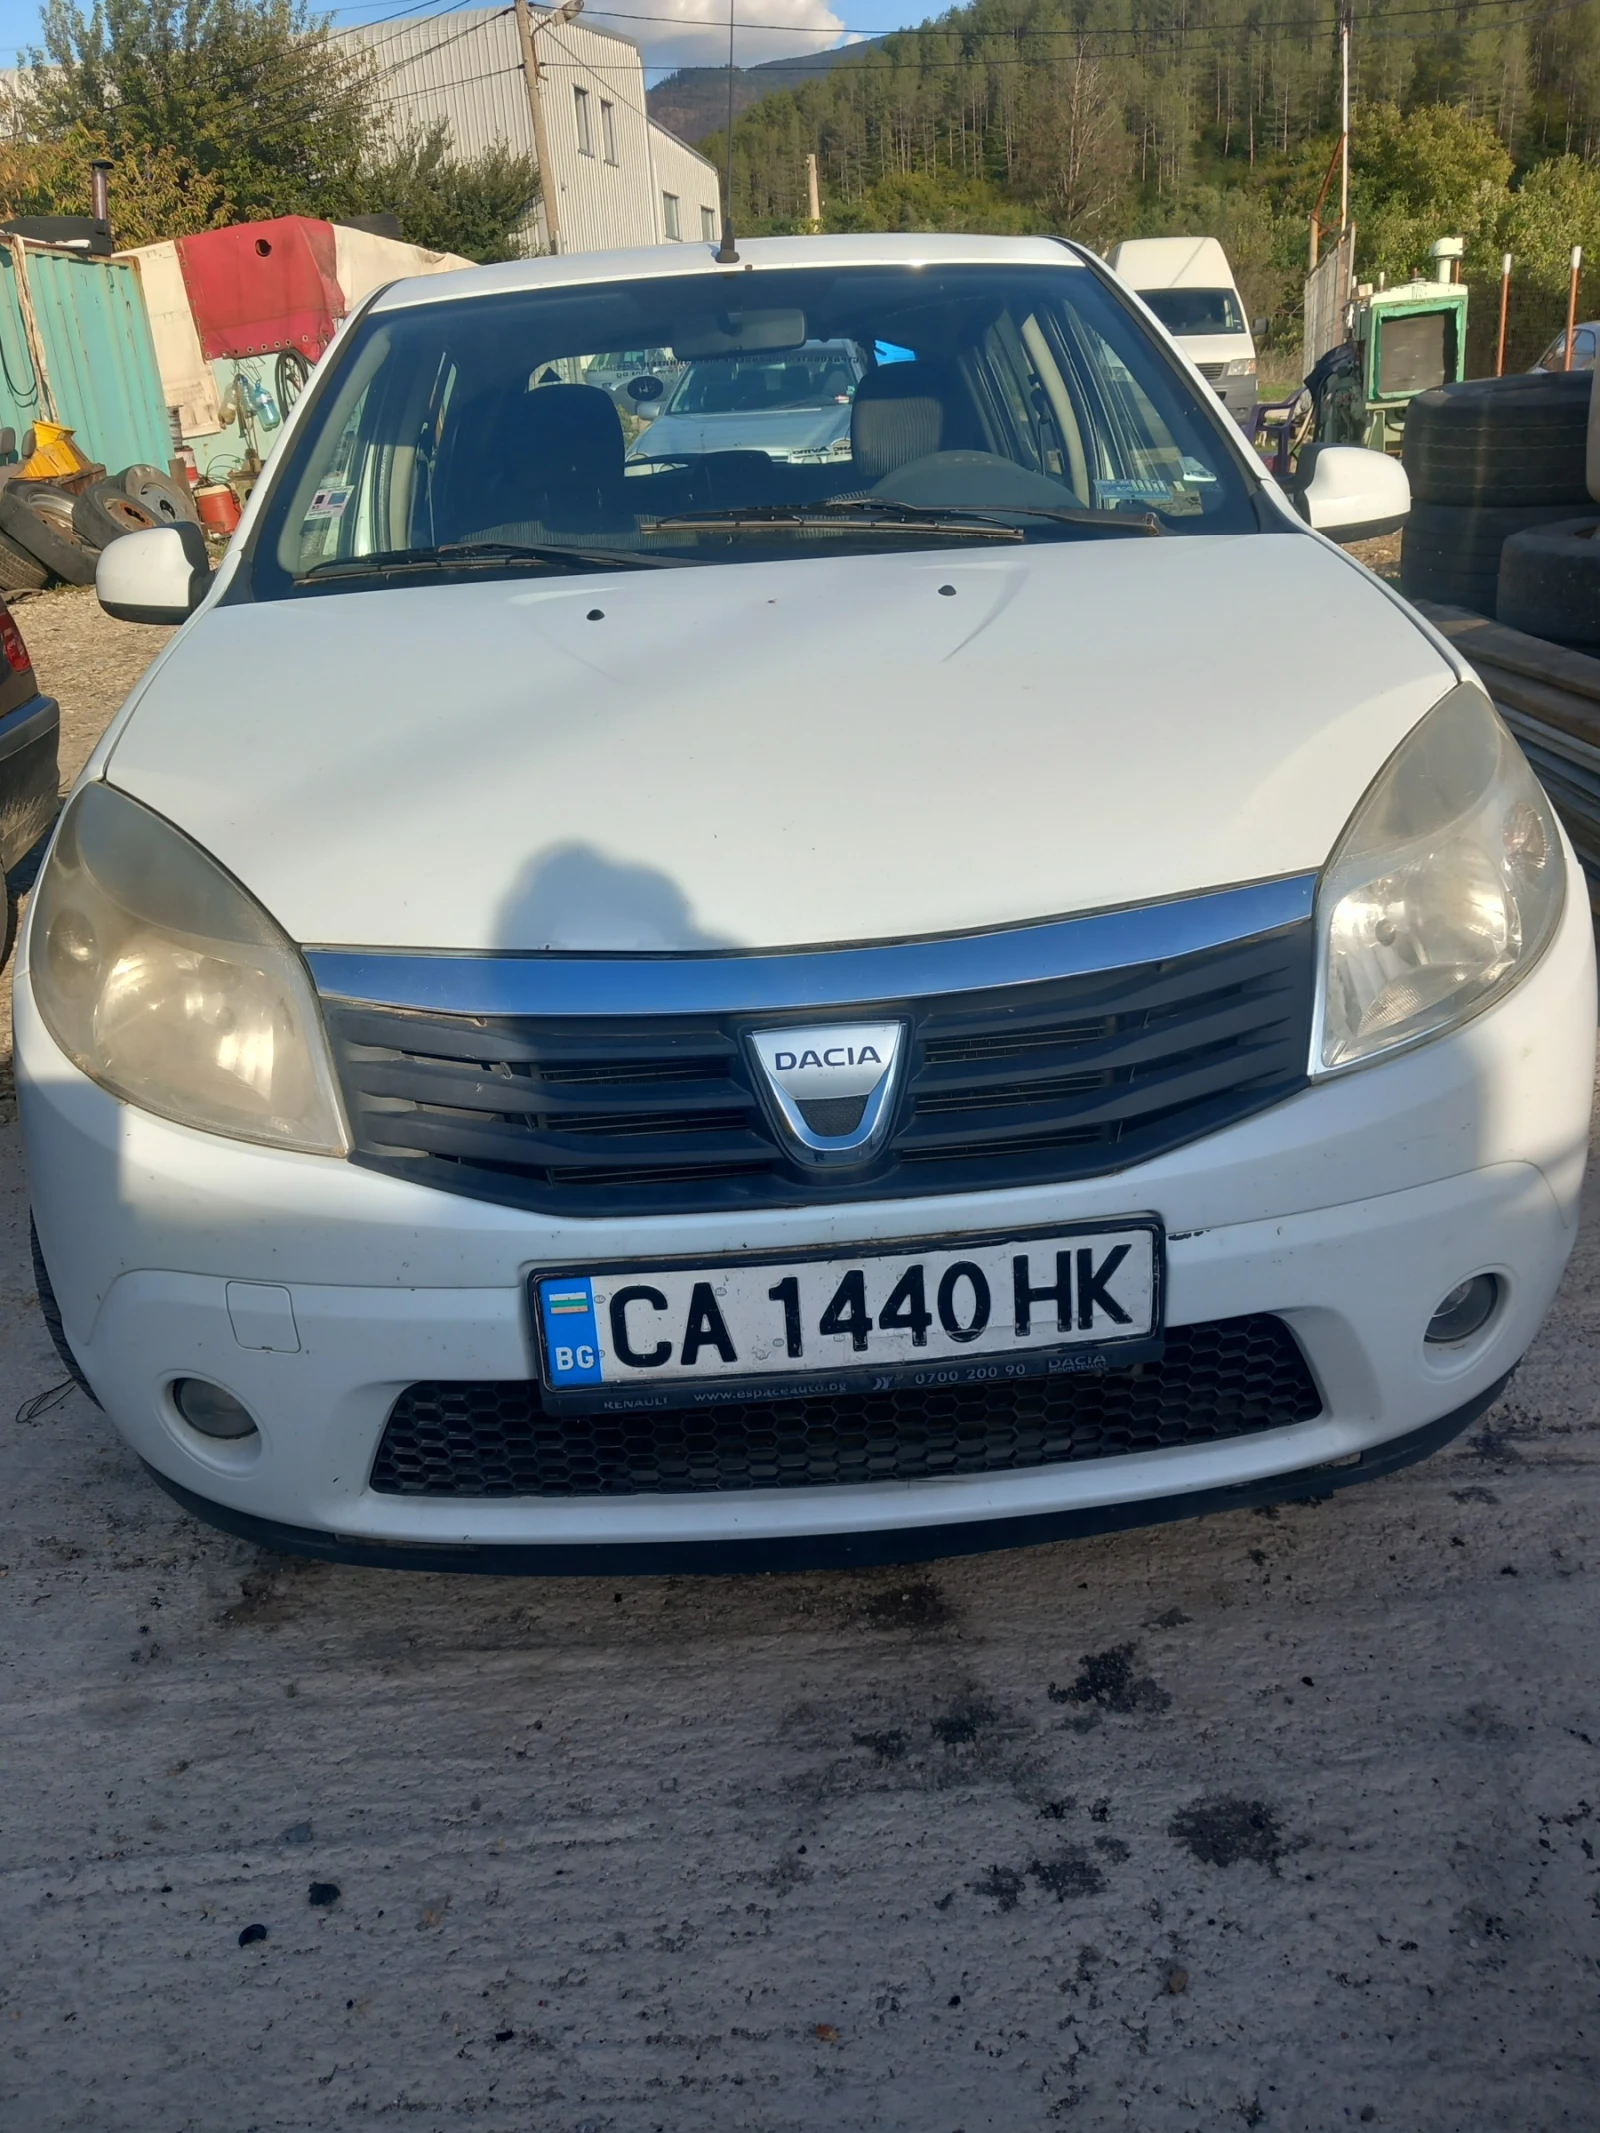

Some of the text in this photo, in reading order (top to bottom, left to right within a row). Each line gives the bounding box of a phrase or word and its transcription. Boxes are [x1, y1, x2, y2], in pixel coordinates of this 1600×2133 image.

[774, 1045, 882, 1071] DACIA
[609, 1243, 1134, 1368] CA 1440 HK
[555, 1344, 594, 1371] BG
[1048, 1354, 1107, 1369] DACIA
[914, 1370, 959, 1385] 0700
[965, 1366, 998, 1381] 200
[1004, 1363, 1026, 1377] 90
[693, 1382, 847, 1402] www.espaceauto.bg
[603, 1397, 668, 1410] RENAULT
